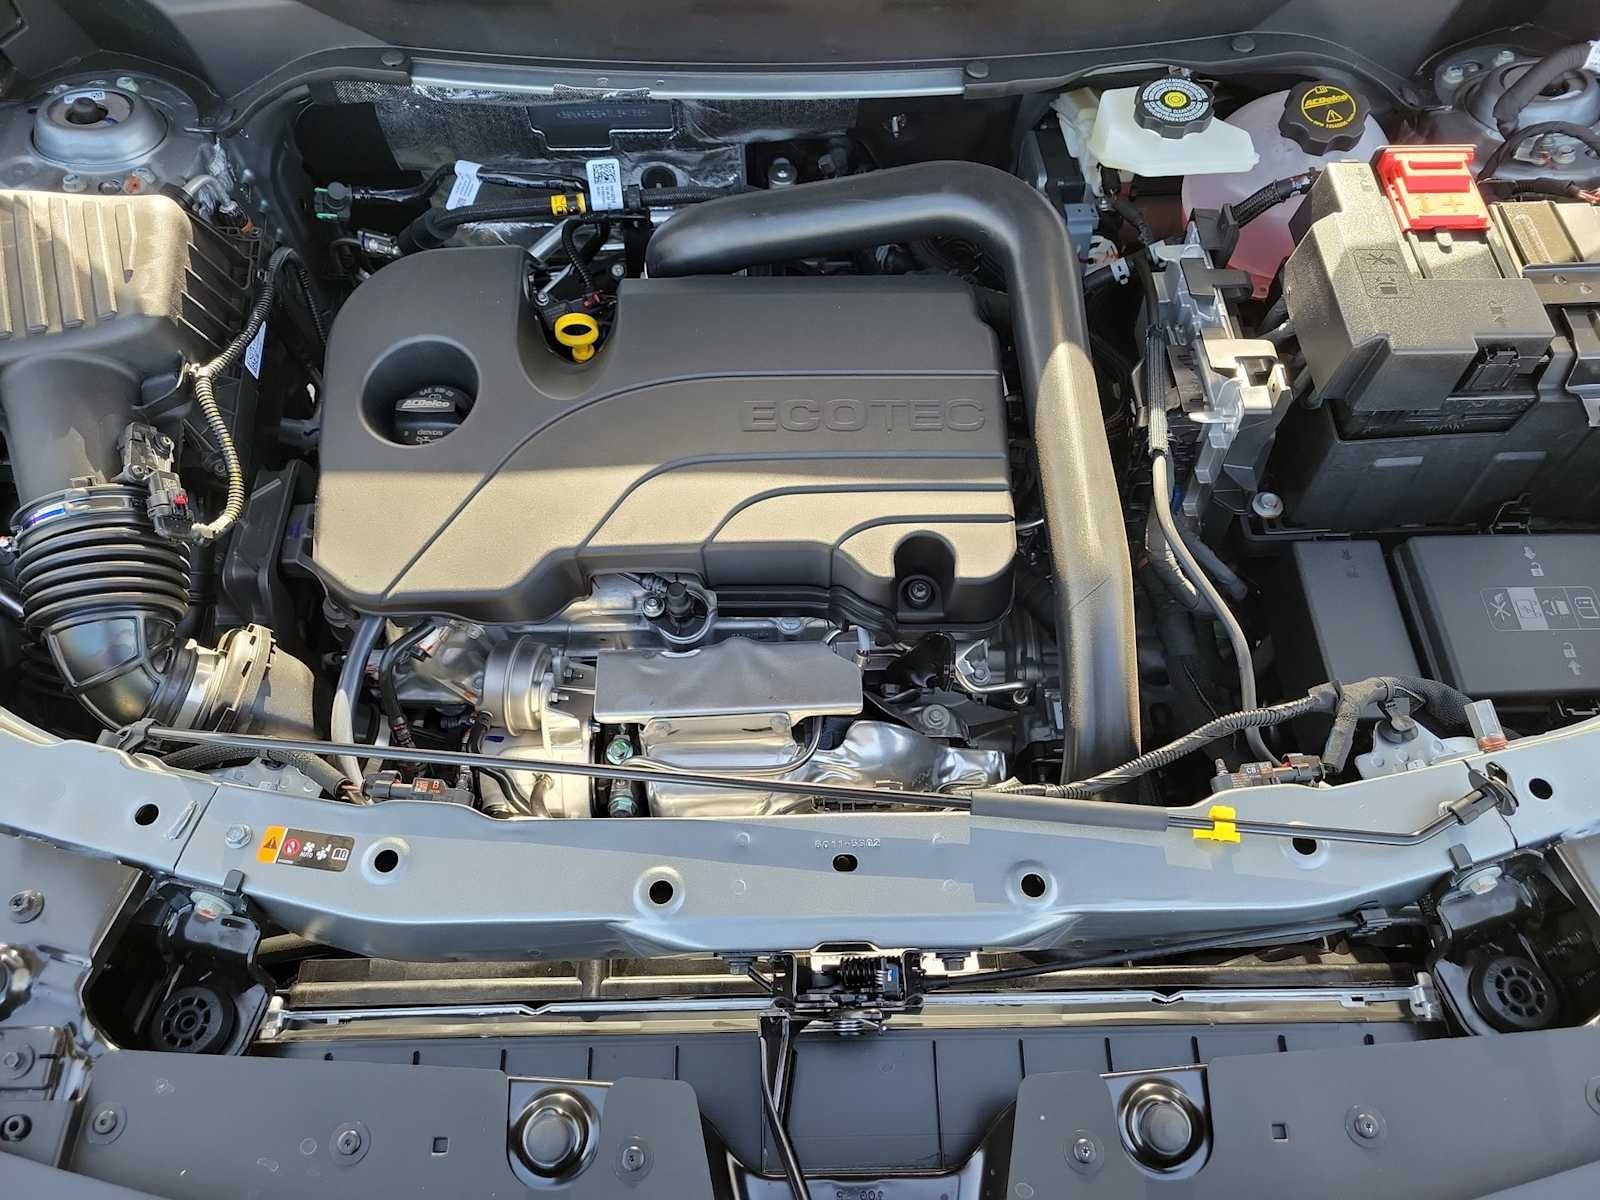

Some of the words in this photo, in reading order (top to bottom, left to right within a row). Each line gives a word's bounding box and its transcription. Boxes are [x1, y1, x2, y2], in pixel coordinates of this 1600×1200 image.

[1303, 94, 1348, 110] ACDelco
[401, 399, 450, 409] ACDelco
[743, 399, 985, 432] ECOTEC
